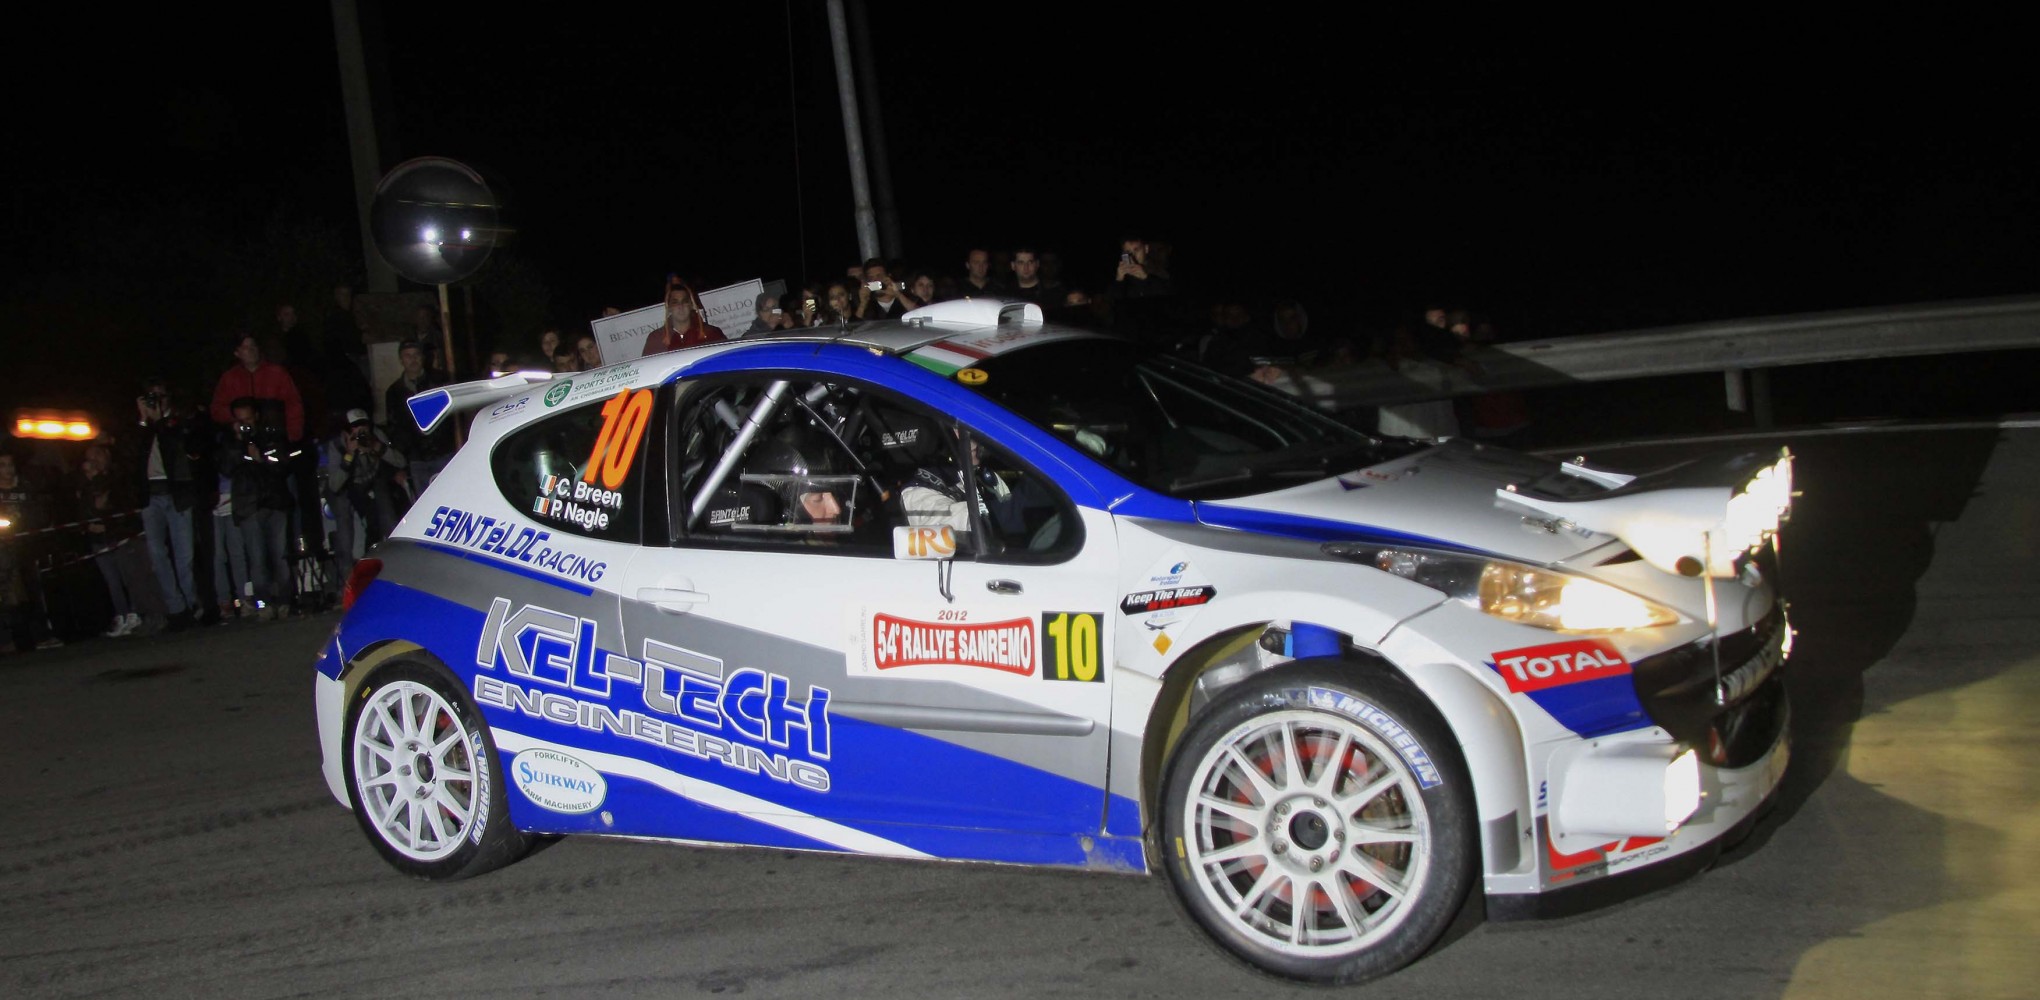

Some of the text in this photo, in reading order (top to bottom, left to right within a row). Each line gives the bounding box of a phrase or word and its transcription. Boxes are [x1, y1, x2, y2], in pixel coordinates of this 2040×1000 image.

[609, 323, 660, 343] BENVEN
[574, 368, 640, 392] SPORTS COUNCIL
[584, 387, 654, 490] 10
[557, 477, 622, 508] C. Breen
[550, 499, 609, 529] P. Nagle
[533, 547, 607, 583] RACING
[1127, 594, 1153, 605] Keep
[1155, 590, 1173, 601] The
[1175, 587, 1203, 599] Race
[937, 610, 968, 621] 2012
[902, 625, 954, 660] RALLYE
[958, 625, 1031, 670] SANREMO
[1049, 612, 1097, 681] 10
[476, 597, 831, 760] KEL-TECH
[1500, 649, 1622, 681] TOTAL
[474, 674, 831, 794] ENGINEERING
[1337, 698, 1439, 783] MICHELIN
[534, 751, 579, 768] FORKLIFTS
[471, 757, 489, 840] MICHELIN
[522, 784, 592, 811] FARM MACHINERY
